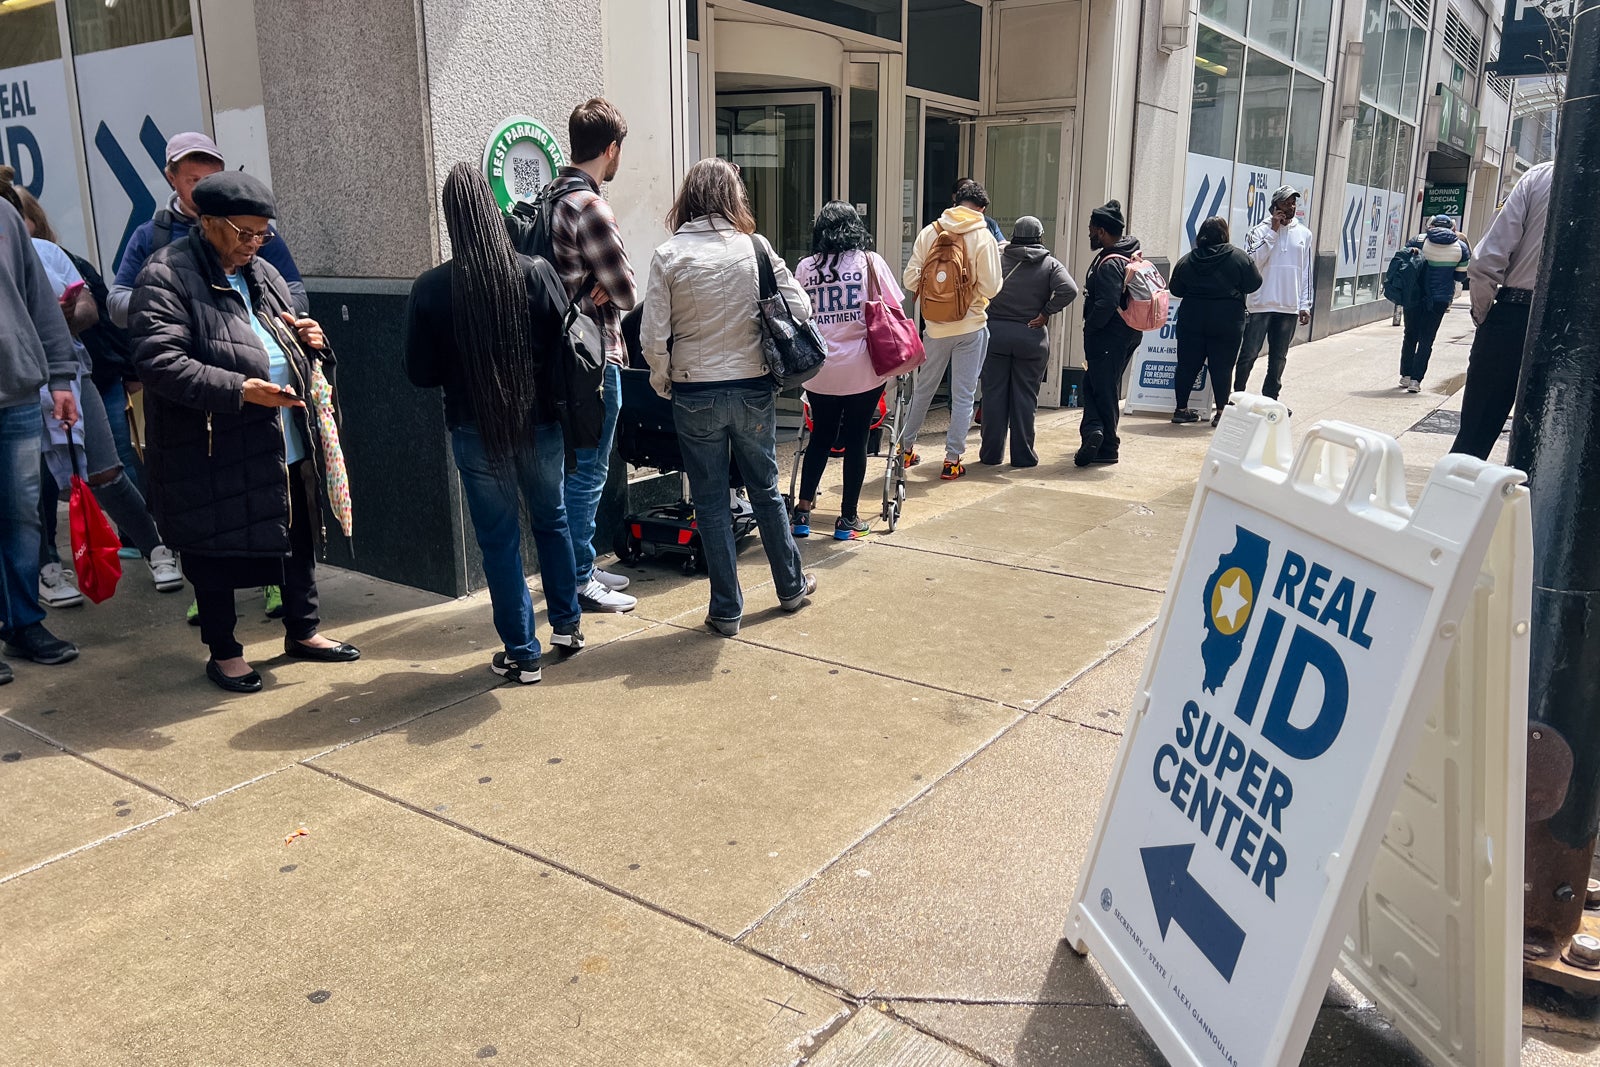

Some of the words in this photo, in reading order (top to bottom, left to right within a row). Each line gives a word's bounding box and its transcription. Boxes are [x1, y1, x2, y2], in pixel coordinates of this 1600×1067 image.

[0, 80, 36, 119] EAL
[493, 139, 508, 177] BEST
[504, 124, 549, 146] PARKING
[547, 142, 563, 176] RAT
[1256, 173, 1268, 189] REAL
[1430, 195, 1457, 203] SPECIAL
[1253, 191, 1266, 227] ID
[805, 285, 862, 313] FIRE
[1147, 346, 1177, 354] WALK-INS
[1153, 371, 1175, 379] REQUIRED
[1272, 549, 1377, 650] REAL
[1233, 607, 1349, 760] ID
[1176, 700, 1293, 834] SUPER
[1153, 743, 1287, 903] CENTER
[1114, 908, 1143, 950] SECRETARY
[1142, 946, 1149, 956] of
[1148, 952, 1167, 979] STATE
[1173, 984, 1192, 1010] ALEXI
[1191, 1008, 1239, 1067] GIANNOULIAS
